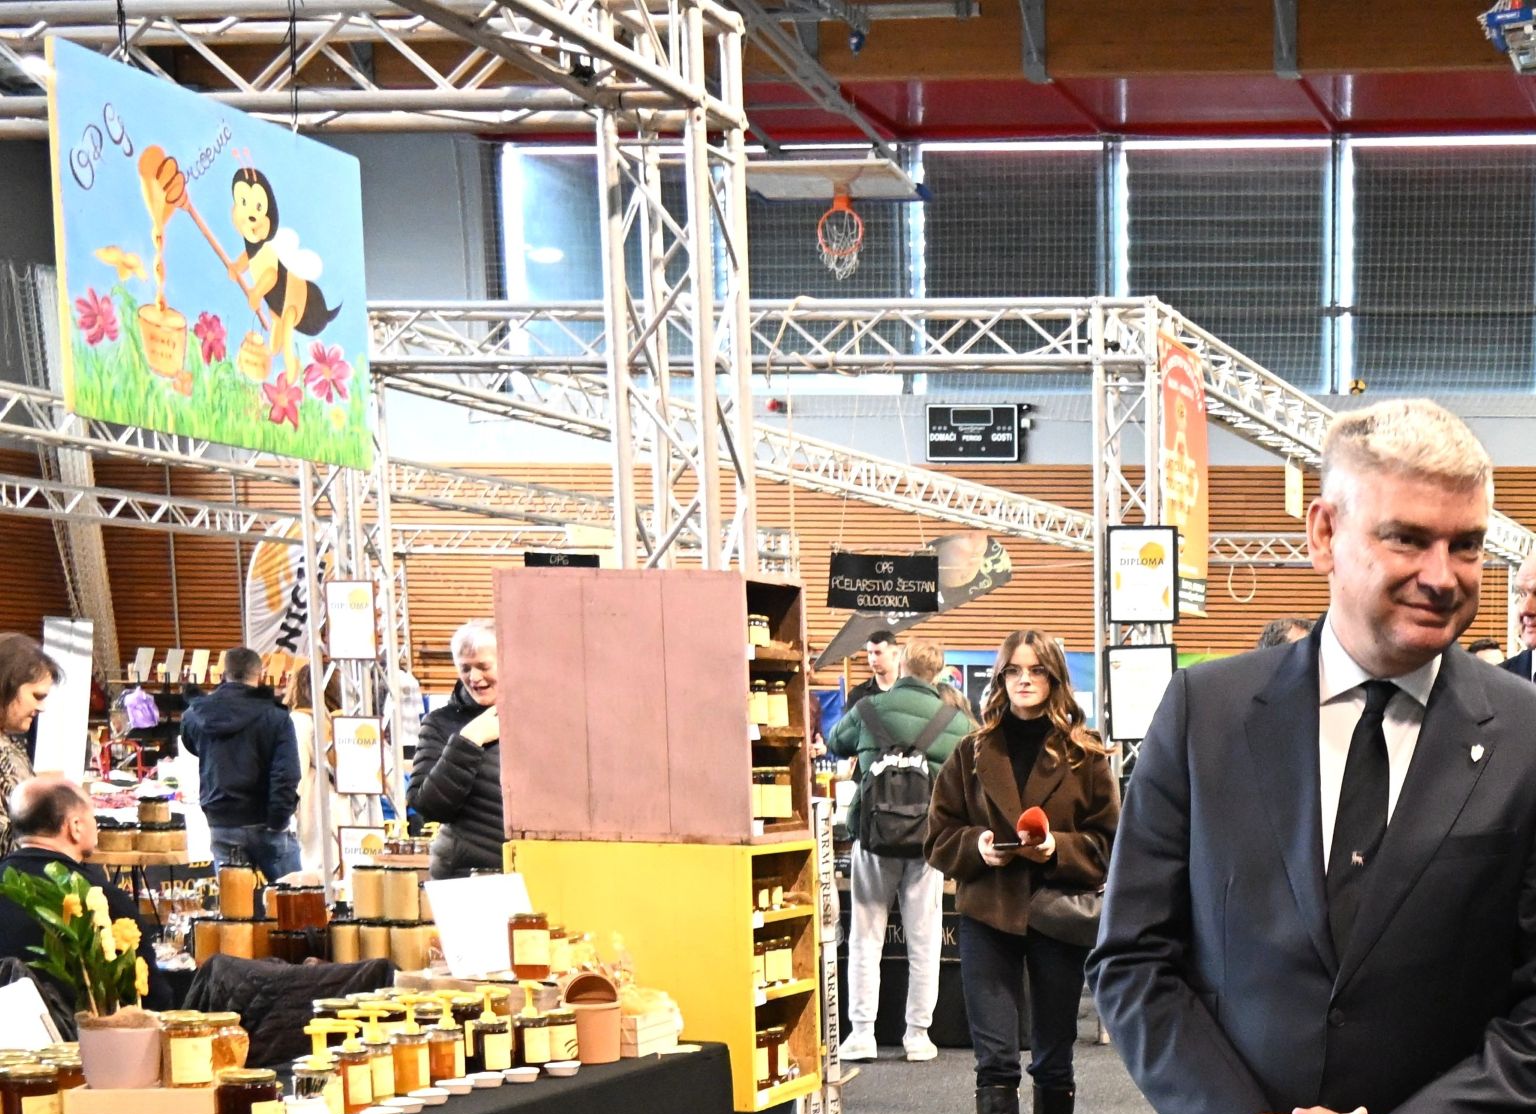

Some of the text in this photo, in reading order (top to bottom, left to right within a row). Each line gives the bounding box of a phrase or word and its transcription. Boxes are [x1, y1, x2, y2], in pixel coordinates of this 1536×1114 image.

[991, 432, 1013, 442] GOSTI
[875, 561, 894, 574] OPG
[1119, 557, 1164, 566] DIPLOMA
[831, 575, 935, 592] PČELARSTVO ŠESTAN
[856, 594, 910, 607] GOLOGORICA
[344, 847, 384, 855] DIPLOMA
[821, 817, 832, 926] FARM FRESH
[827, 960, 838, 1067] FARM FRESH
